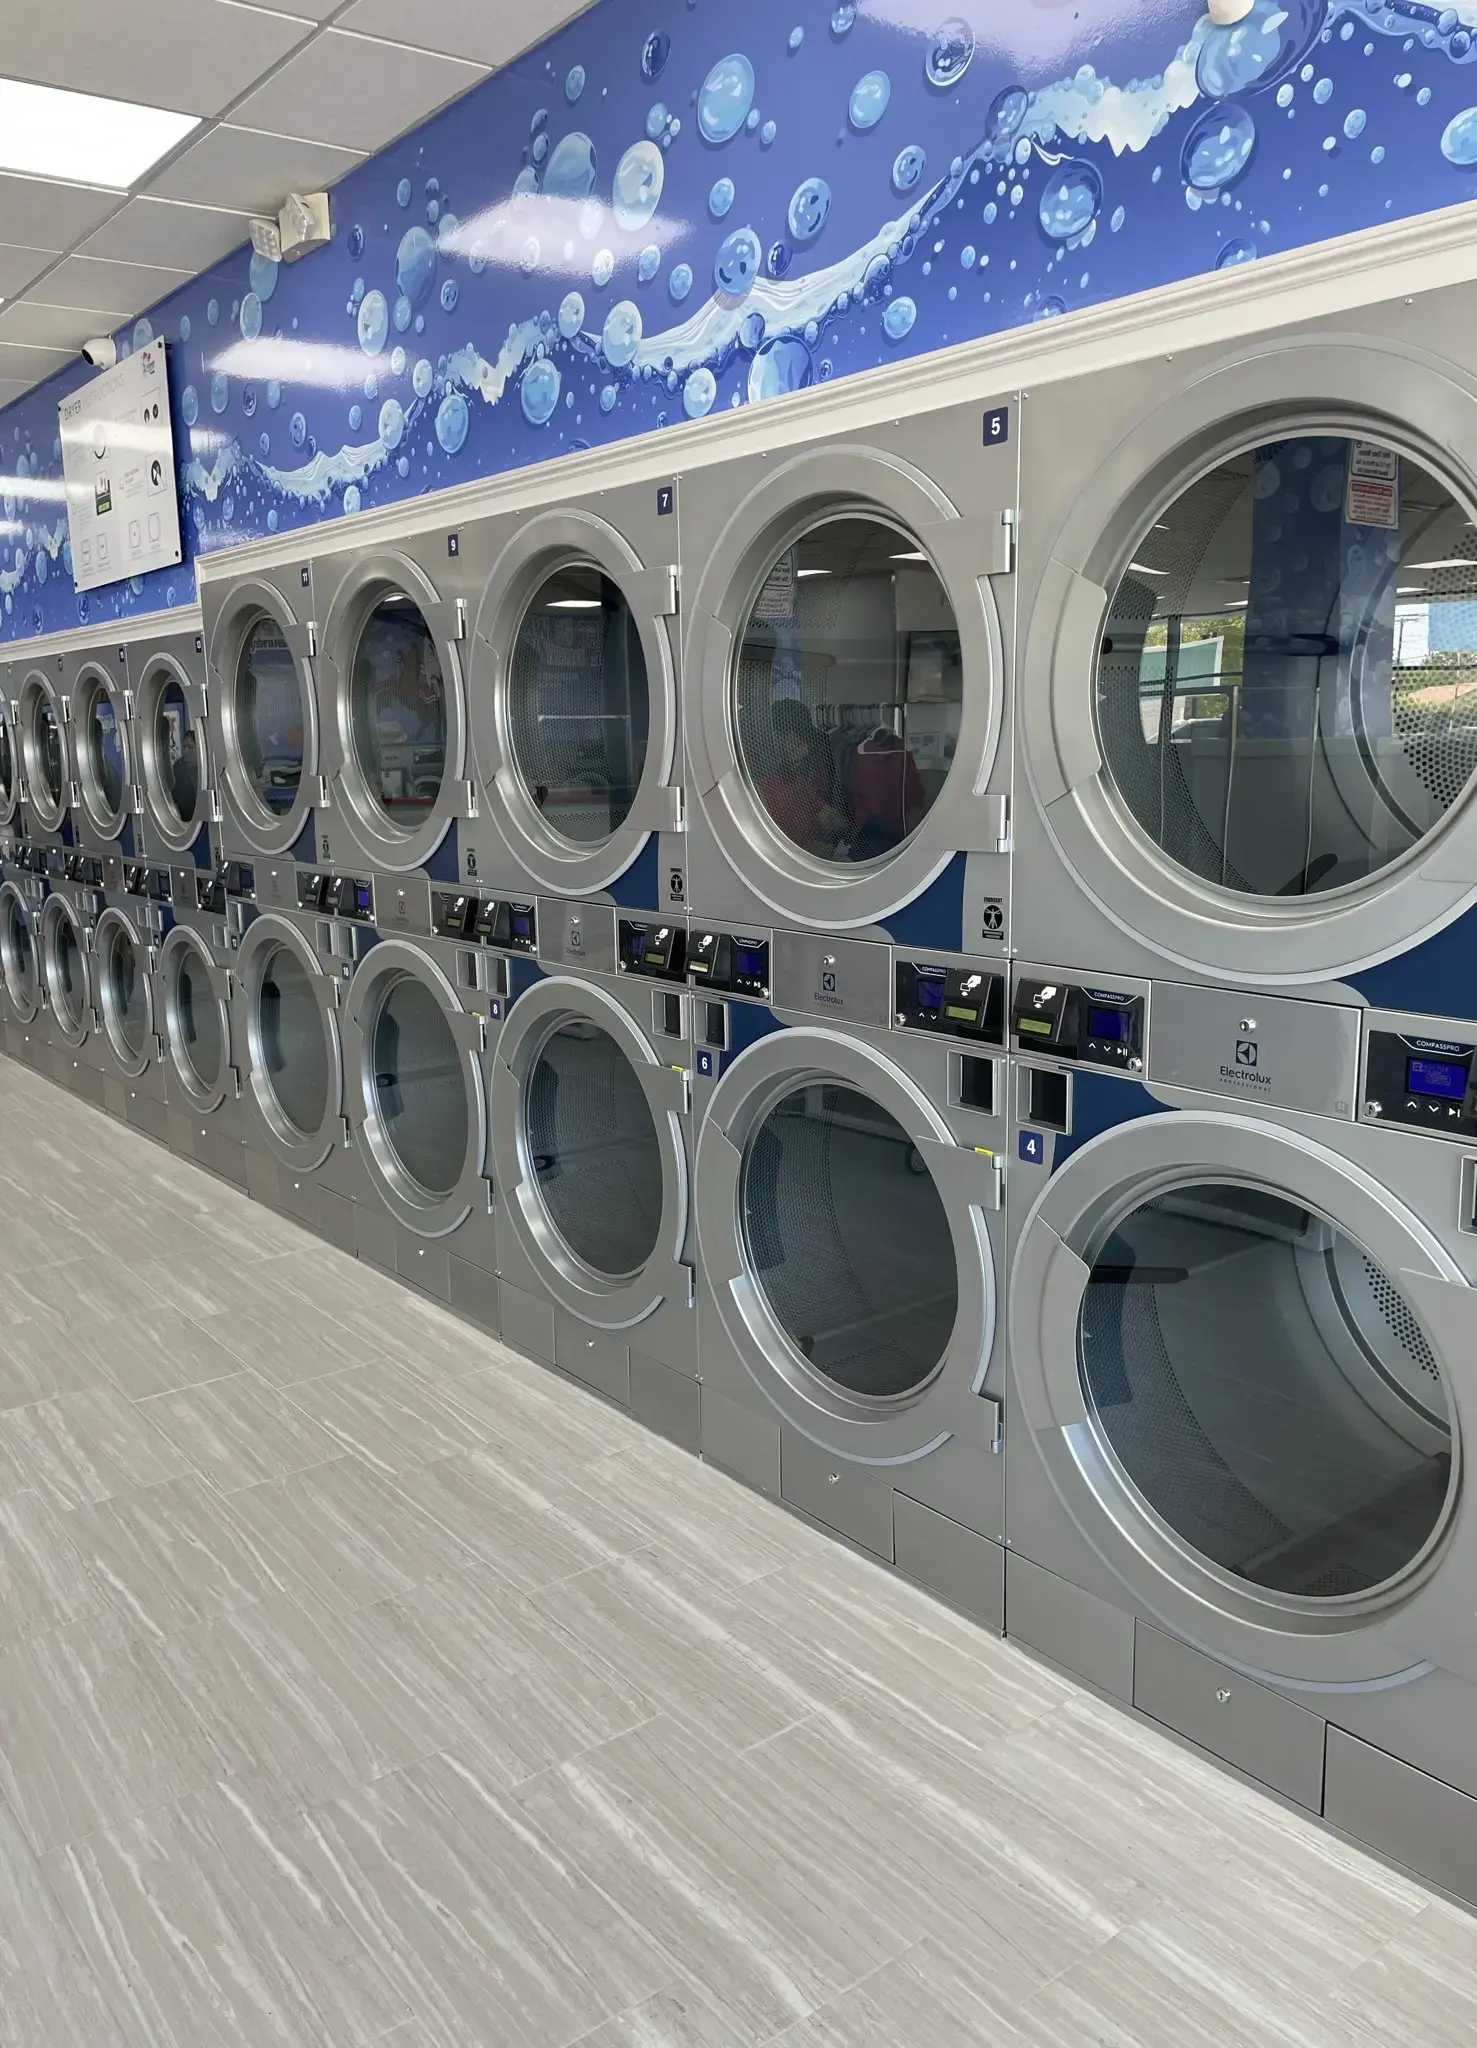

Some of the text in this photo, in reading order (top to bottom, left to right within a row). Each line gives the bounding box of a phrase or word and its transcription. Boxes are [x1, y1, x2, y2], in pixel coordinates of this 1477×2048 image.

[64, 399, 82, 421] DRYER
[991, 416, 1001, 436] 5
[661, 493, 669, 508] 7
[450, 539, 456, 551] 9
[302, 572, 308, 582] 11
[814, 991, 844, 1006] Electrolux
[1093, 990, 1125, 1002] COMPASSPRO
[493, 1003, 498, 1015] 8
[1416, 1039, 1460, 1052] COMPASSPRO
[701, 1056, 708, 1070] 6
[1220, 1065, 1272, 1085] Electrolux
[1219, 1078, 1271, 1093] PROFESSIONAL
[1026, 1138, 1036, 1155] 4
